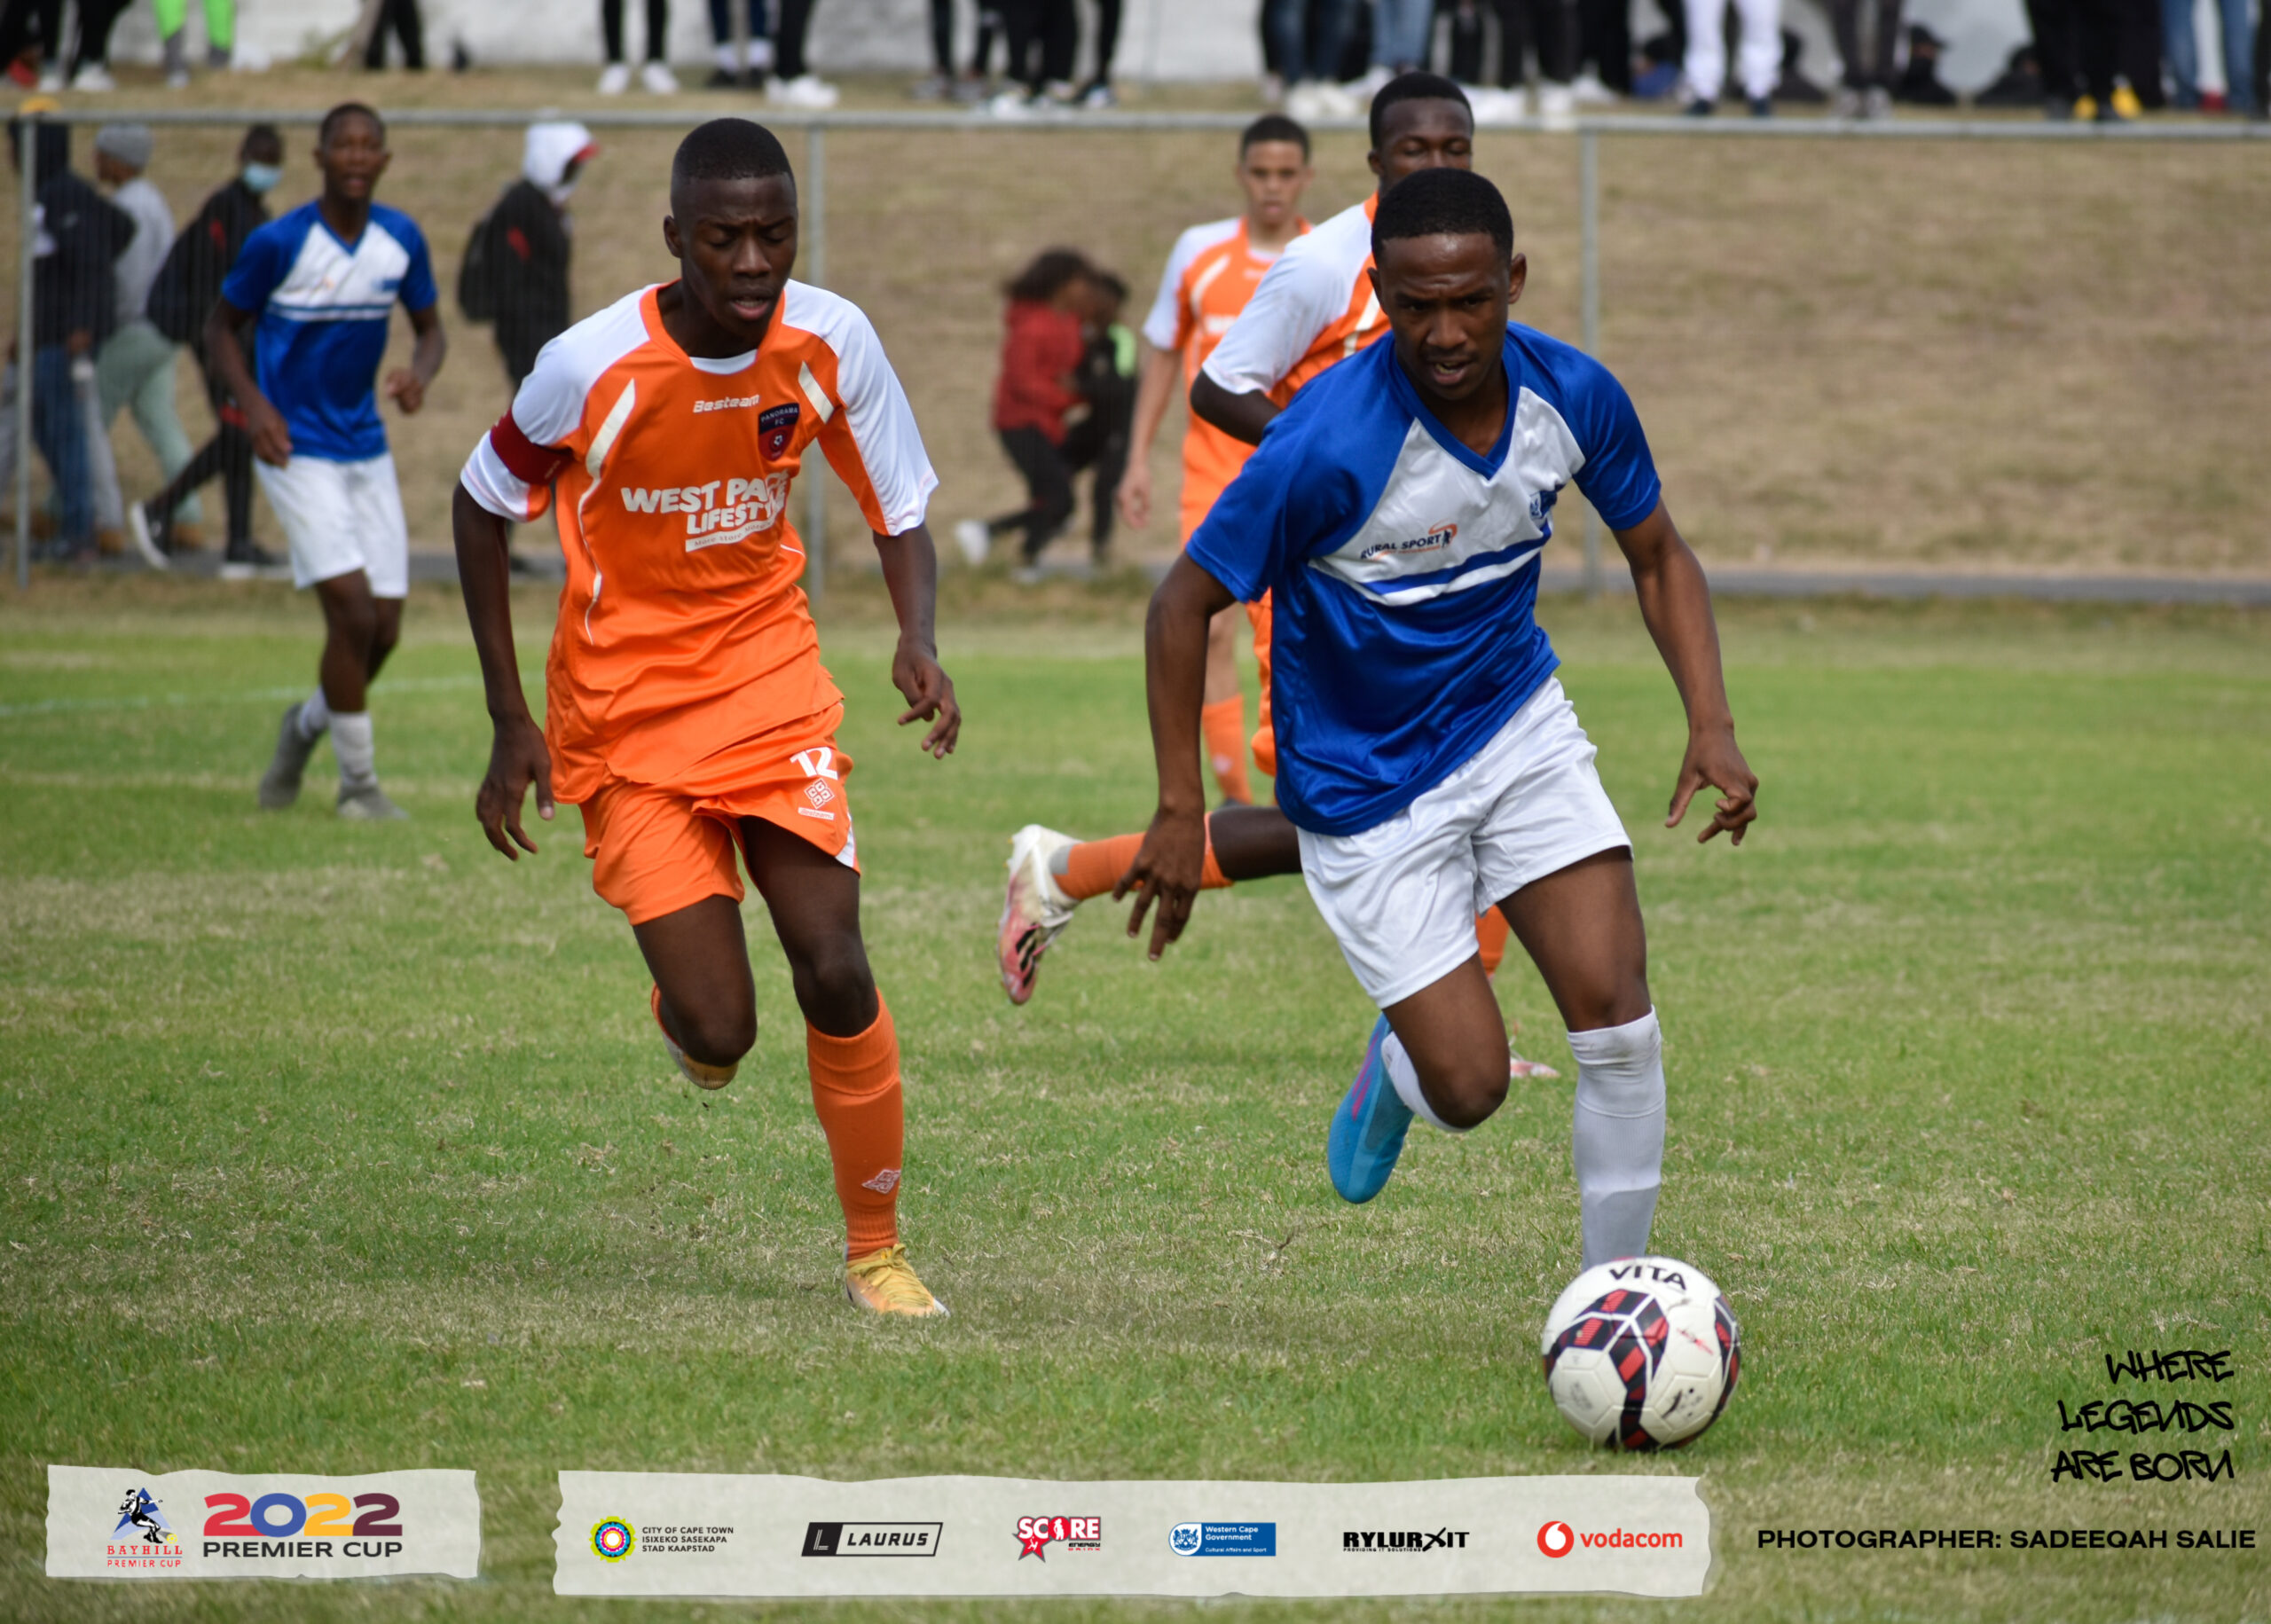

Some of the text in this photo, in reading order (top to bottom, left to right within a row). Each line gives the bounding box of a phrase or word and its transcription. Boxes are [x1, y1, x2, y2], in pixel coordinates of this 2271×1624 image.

[693, 394, 760, 413] Besteam
[760, 406, 798, 423] PANORAMA
[620, 480, 721, 514] WEST
[1360, 542, 1398, 560] RURAL
[1401, 533, 1442, 550] SPORT
[789, 746, 839, 781] 12
[1608, 1264, 1687, 1291] VITA
